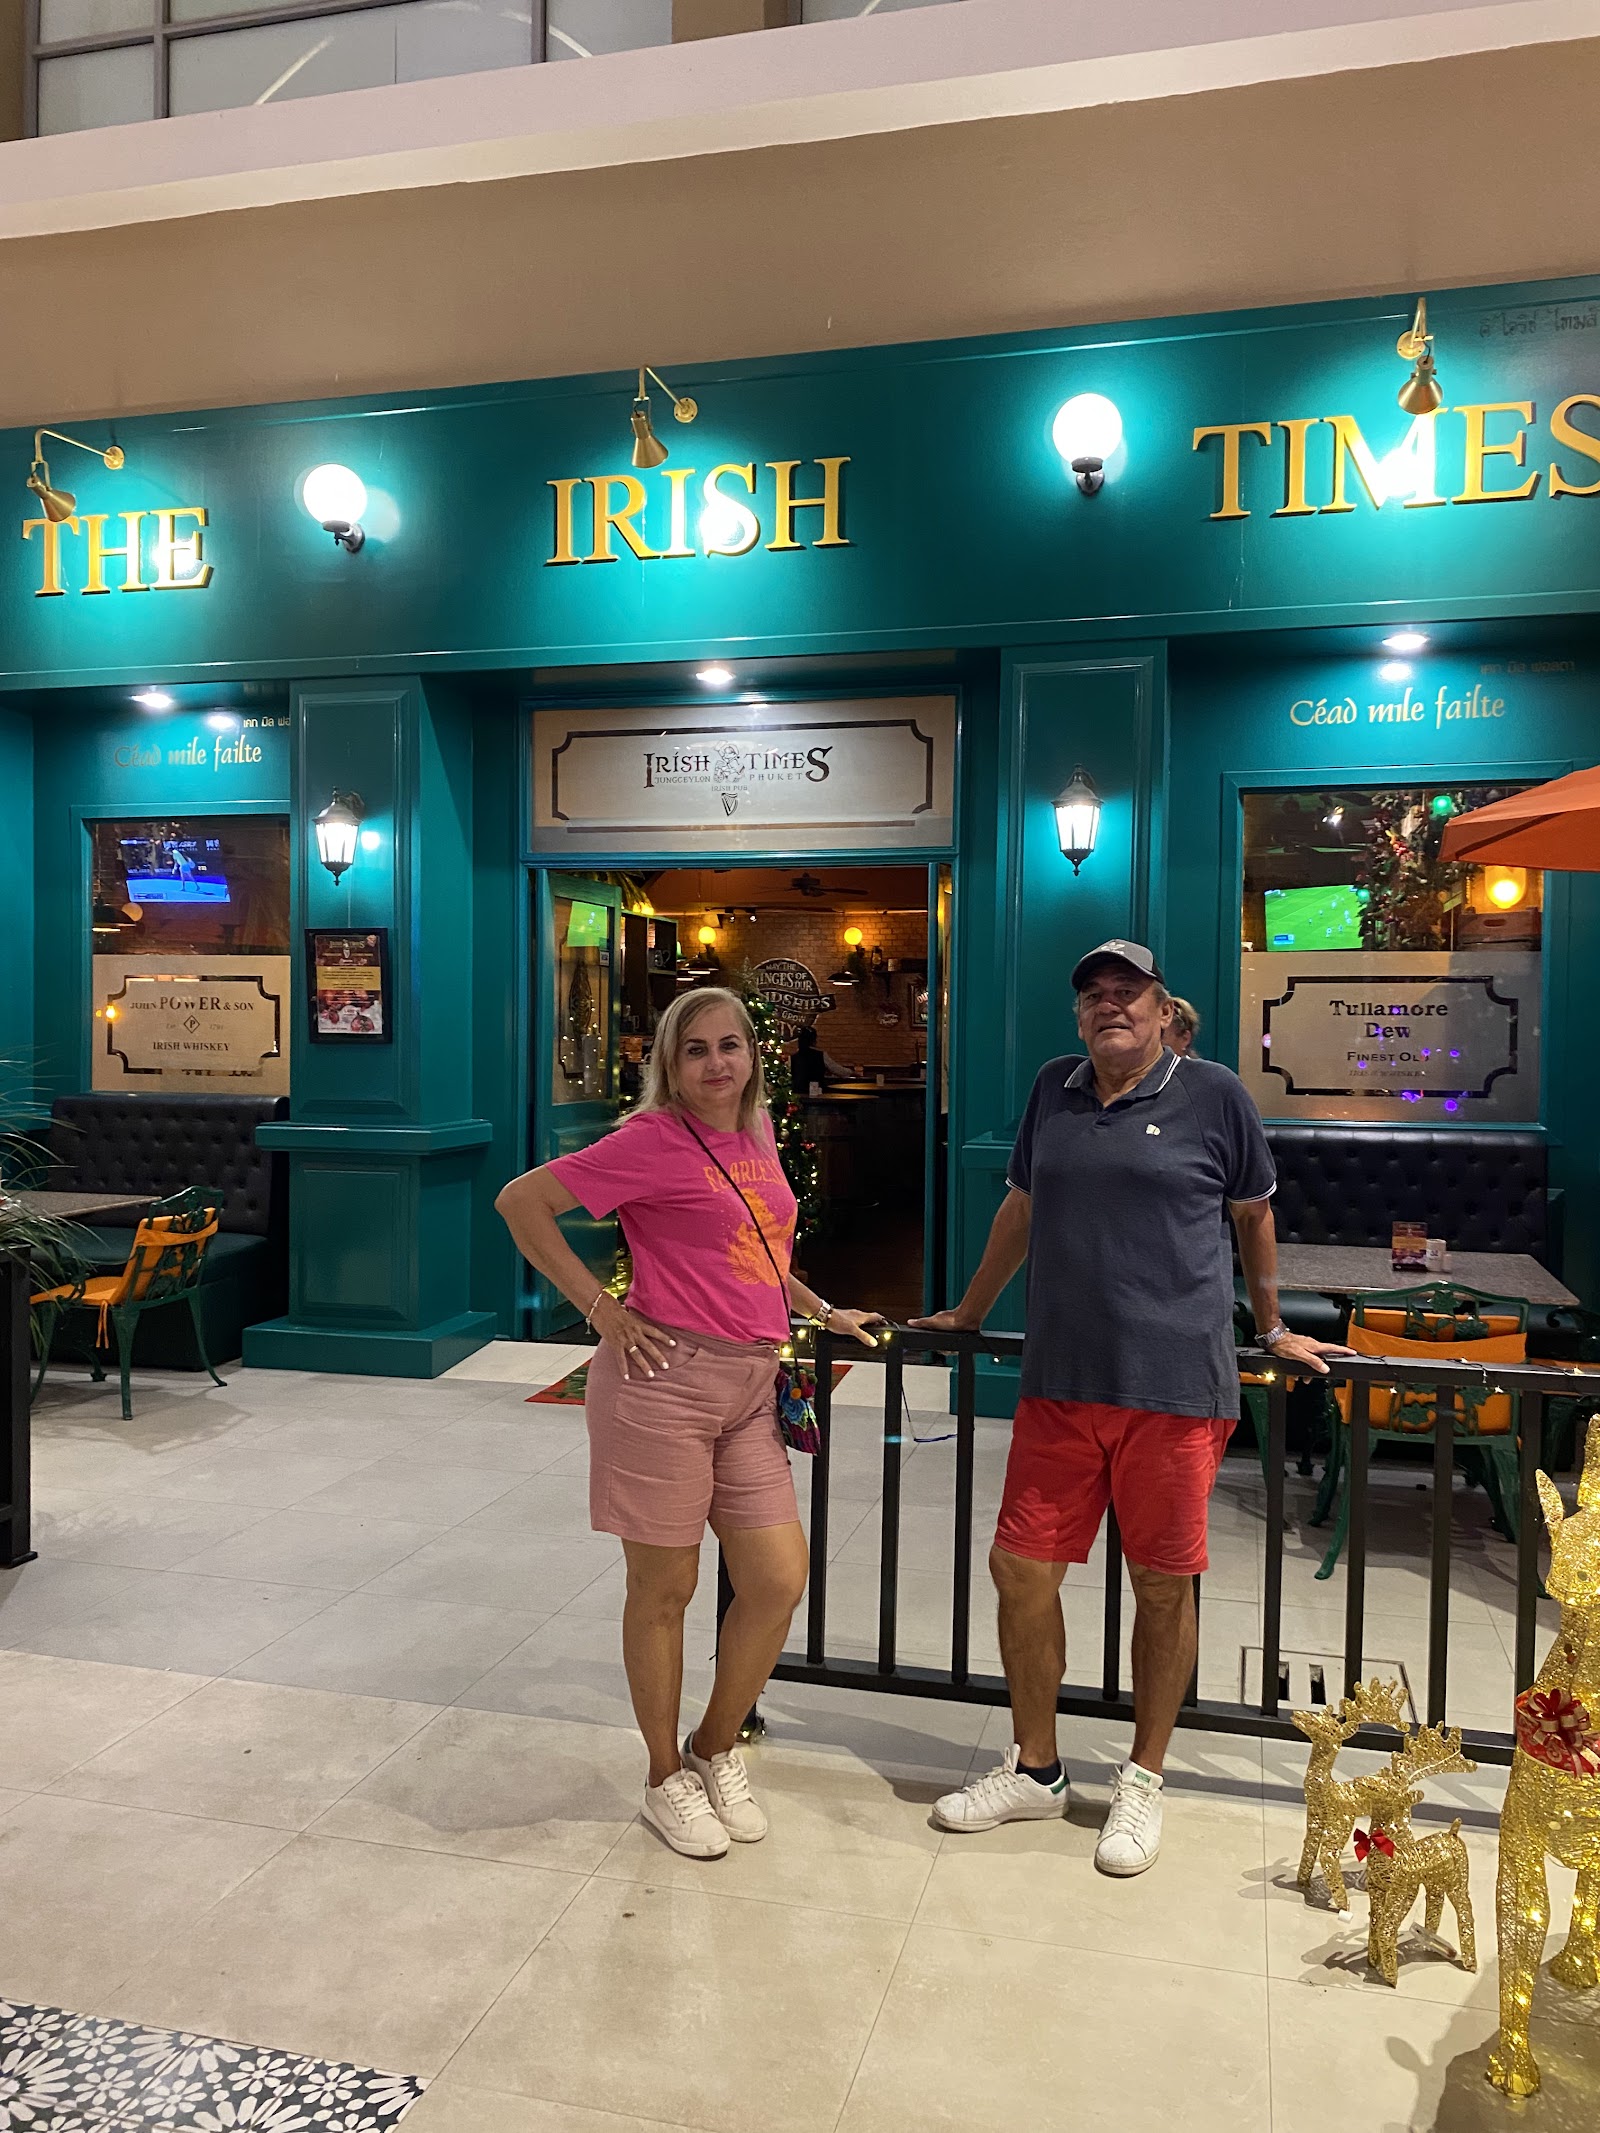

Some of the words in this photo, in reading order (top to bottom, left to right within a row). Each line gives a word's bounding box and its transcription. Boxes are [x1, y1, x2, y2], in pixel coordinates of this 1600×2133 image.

[22, 506, 211, 597] THE
[545, 456, 851, 566] IRISH
[1191, 393, 1600, 520] TIMES
[1434, 683, 1506, 730] failte
[213, 734, 263, 773] failte
[654, 775, 711, 785] JUNGCEYLON
[749, 772, 804, 782] PHUKET
[159, 996, 222, 1011] POWER
[223, 1002, 231, 1011] &
[234, 1001, 254, 1011] SON
[1328, 999, 1449, 1017] Tullamore
[1363, 1022, 1411, 1039] Dew
[153, 1041, 180, 1051] IRISH
[183, 1042, 231, 1052] WHISKEY
